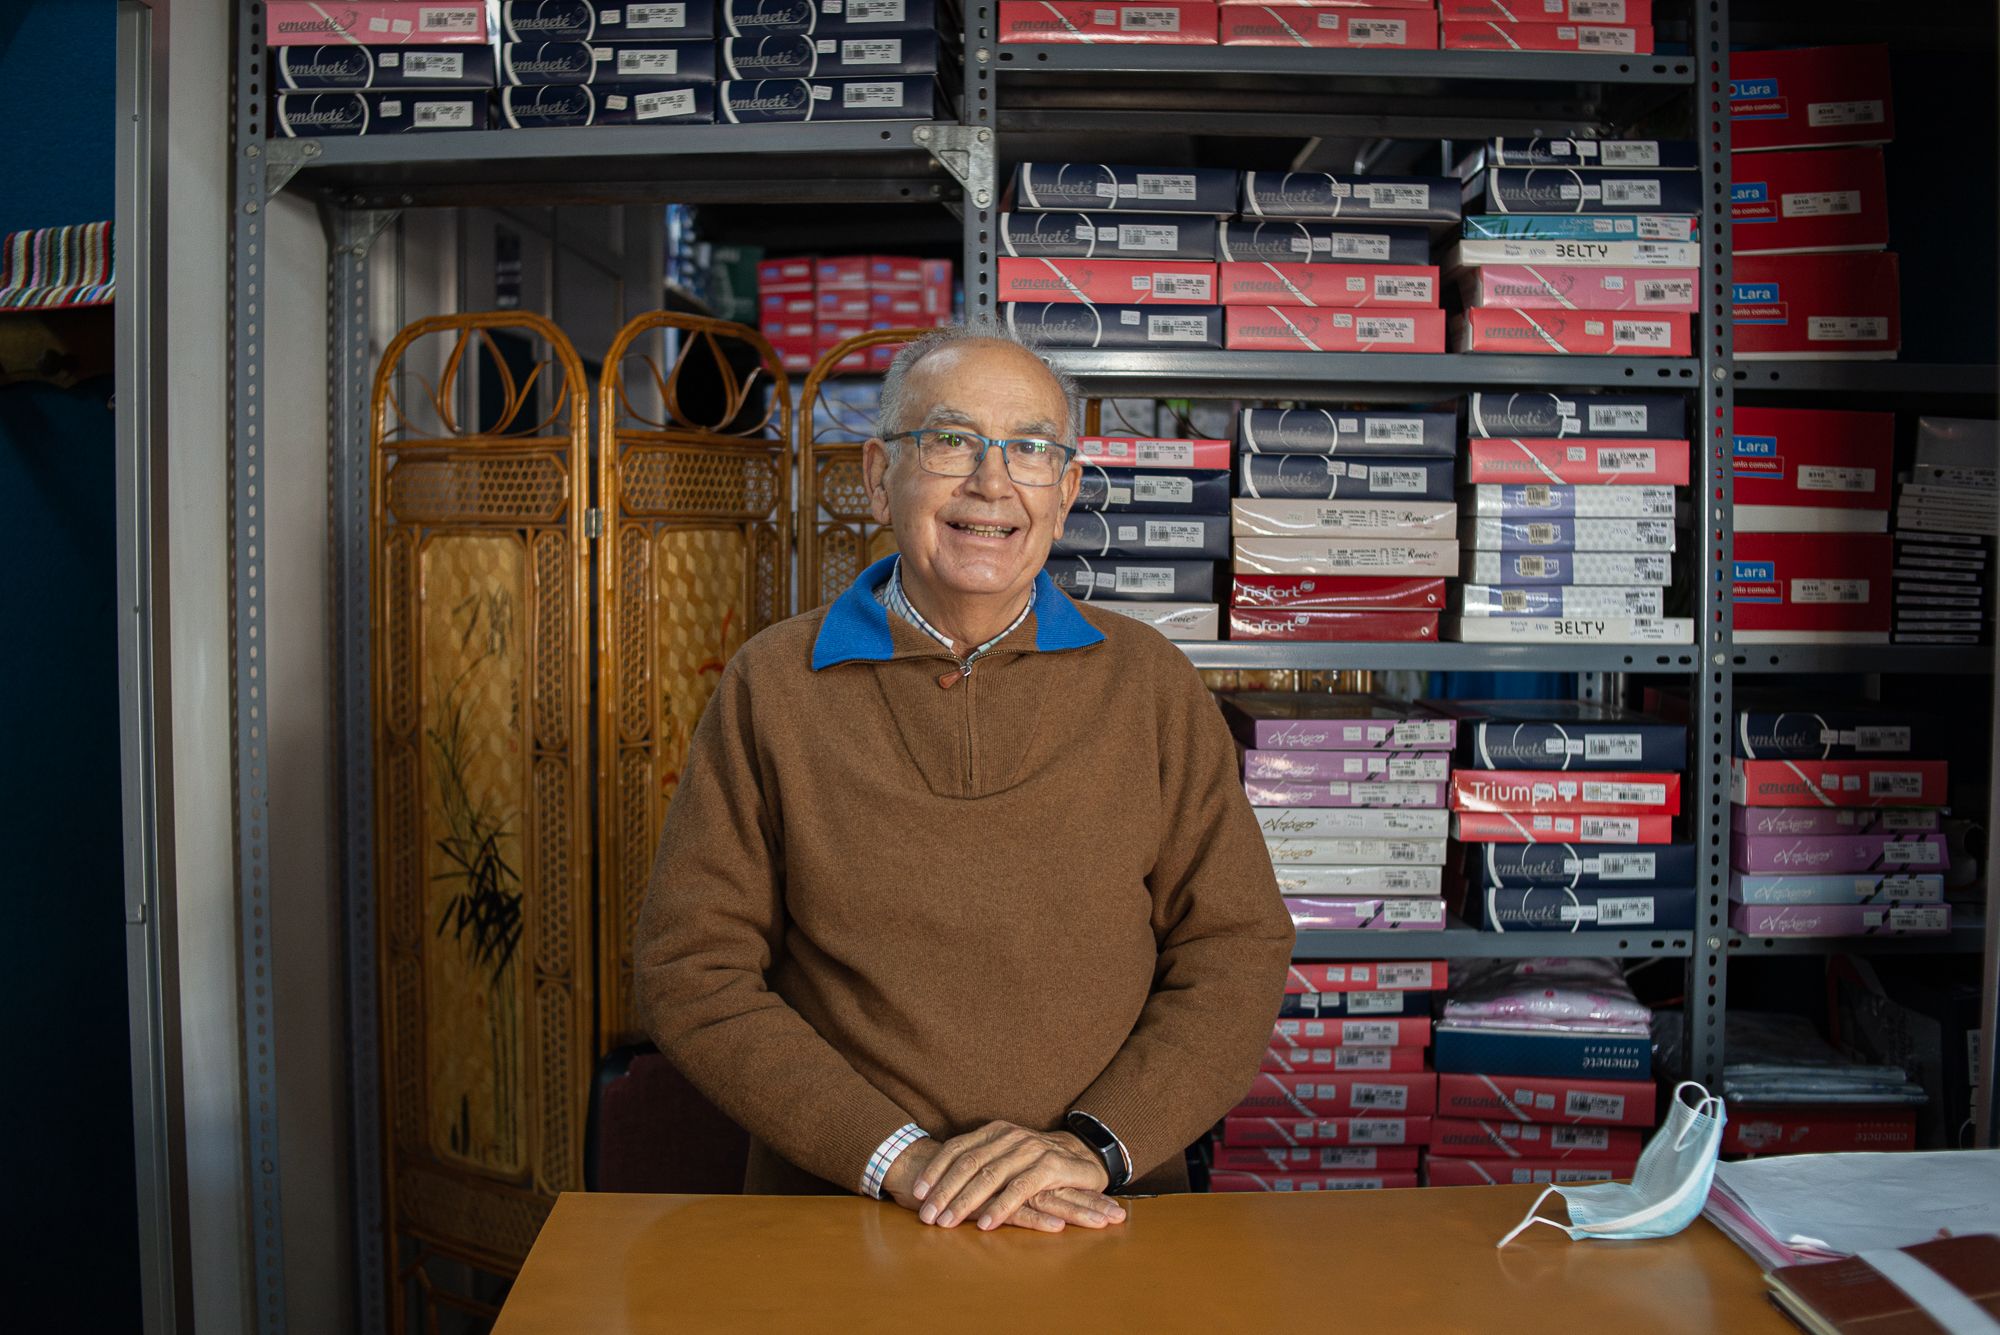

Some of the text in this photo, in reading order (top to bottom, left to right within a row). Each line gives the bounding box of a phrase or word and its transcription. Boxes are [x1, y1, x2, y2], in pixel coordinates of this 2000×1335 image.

[511, 15, 571, 29] emeneté
[733, 8, 792, 24] emeneté
[733, 50, 792, 66] emeneté
[287, 59, 348, 74] emeneté
[511, 58, 571, 73] emeneté
[1741, 83, 1770, 96] Lara
[729, 94, 788, 109] emeneté
[286, 107, 345, 122] emeneté
[511, 102, 571, 116] emeneté
[1032, 180, 1093, 194] emeneté
[1255, 188, 1315, 202] emeneté
[1009, 230, 1070, 244] emeneté
[1739, 286, 1771, 300] Lara
[1738, 440, 1769, 453] Lara
[1735, 565, 1767, 578] Lara
[1495, 860, 1555, 874] emeneté
[1496, 905, 1555, 918] emeneté
[1582, 1056, 1639, 1069] emeneté
